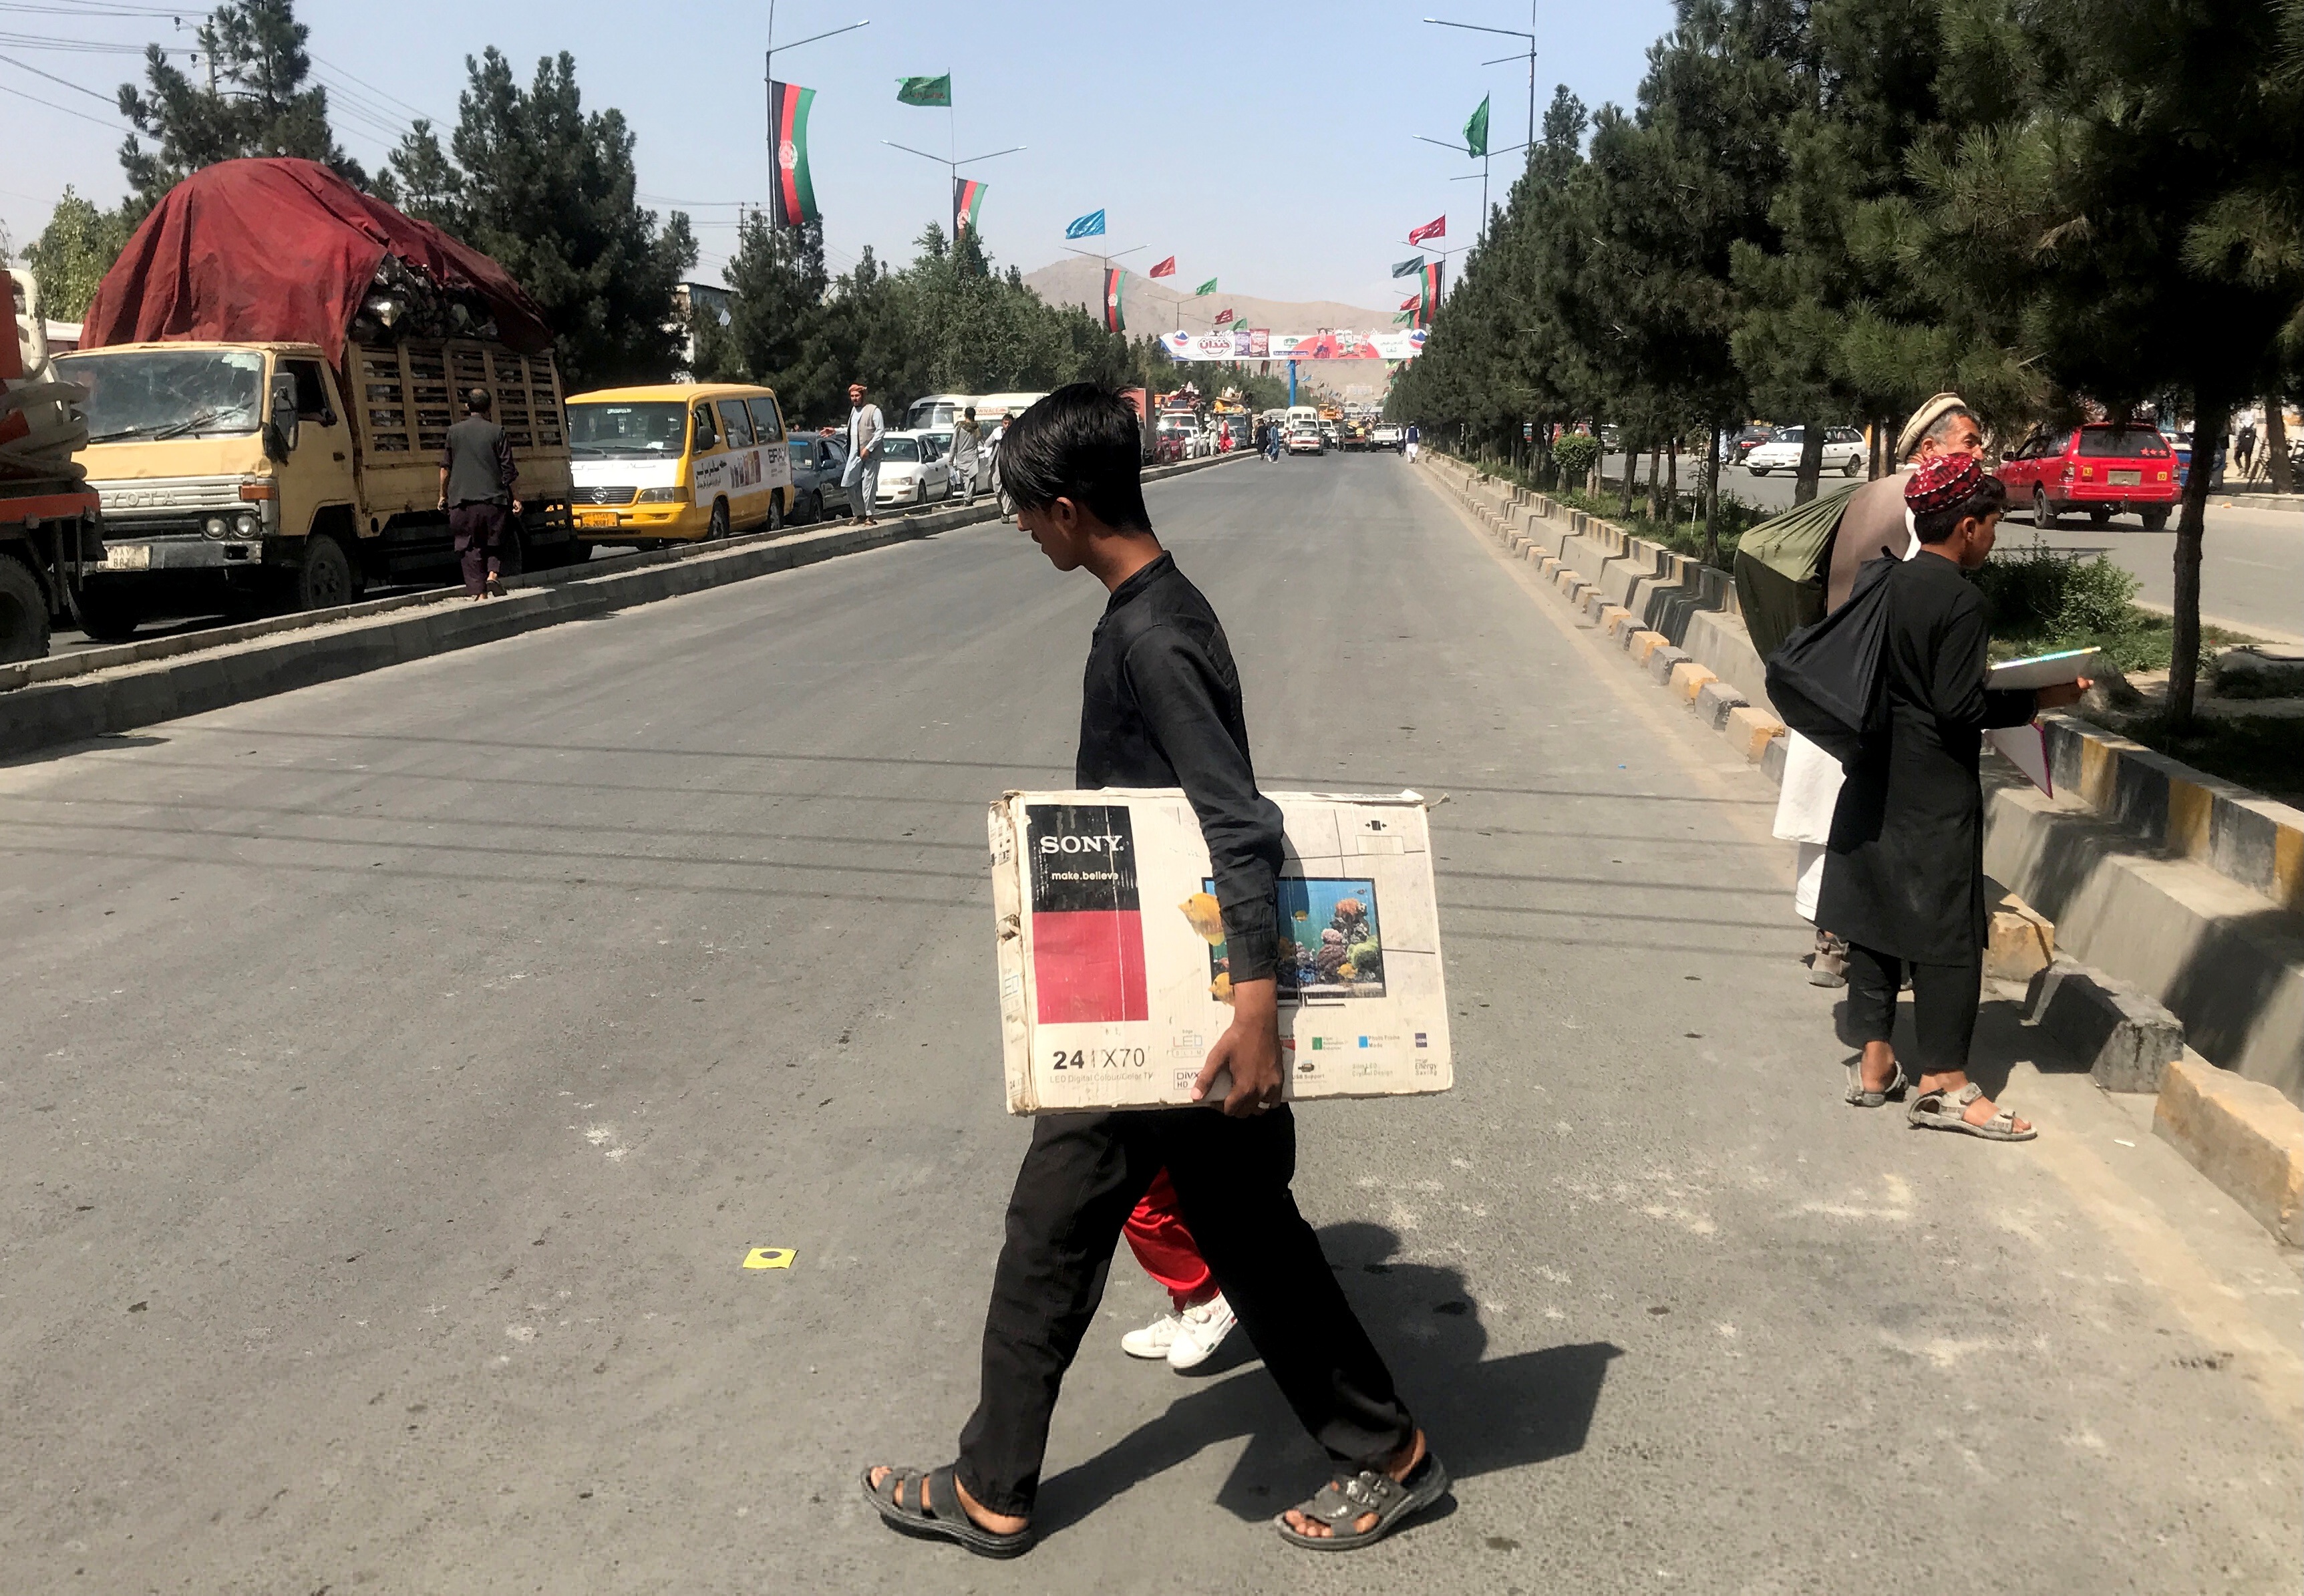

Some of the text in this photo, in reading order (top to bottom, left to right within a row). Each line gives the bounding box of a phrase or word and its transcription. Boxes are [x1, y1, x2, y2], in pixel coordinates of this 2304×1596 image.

[101, 490, 177, 507] YOTA
[1040, 835, 1122, 853] SONY
[1173, 1035, 1202, 1047] LED
[1053, 1050, 1084, 1070] 24
[1415, 1062, 1437, 1070] Energy
[1050, 1075, 1066, 1083] LED
[1068, 1074, 1092, 1084] Digital
